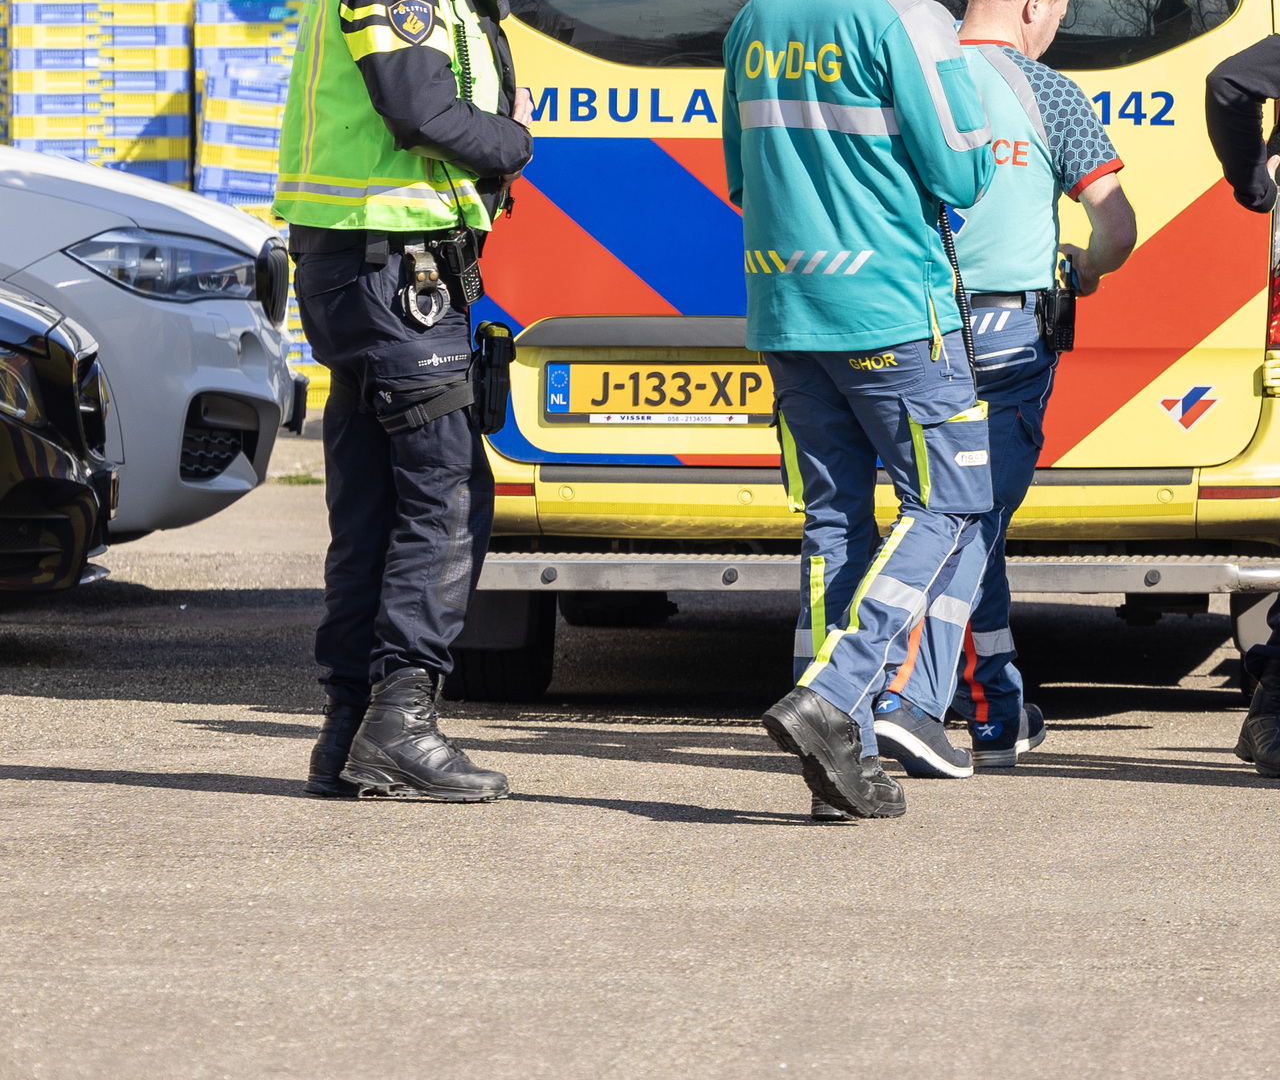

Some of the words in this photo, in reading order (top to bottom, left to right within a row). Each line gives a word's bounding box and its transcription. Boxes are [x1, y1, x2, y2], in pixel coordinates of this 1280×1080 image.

[393, 3, 428, 15] POLITIE
[745, 40, 842, 83] OvD-G
[526, 87, 719, 123] MBULA
[427, 353, 459, 366] POLITIE
[849, 353, 898, 371] GHOR
[591, 371, 762, 406] J-133-XP
[550, 393, 567, 405] NL
